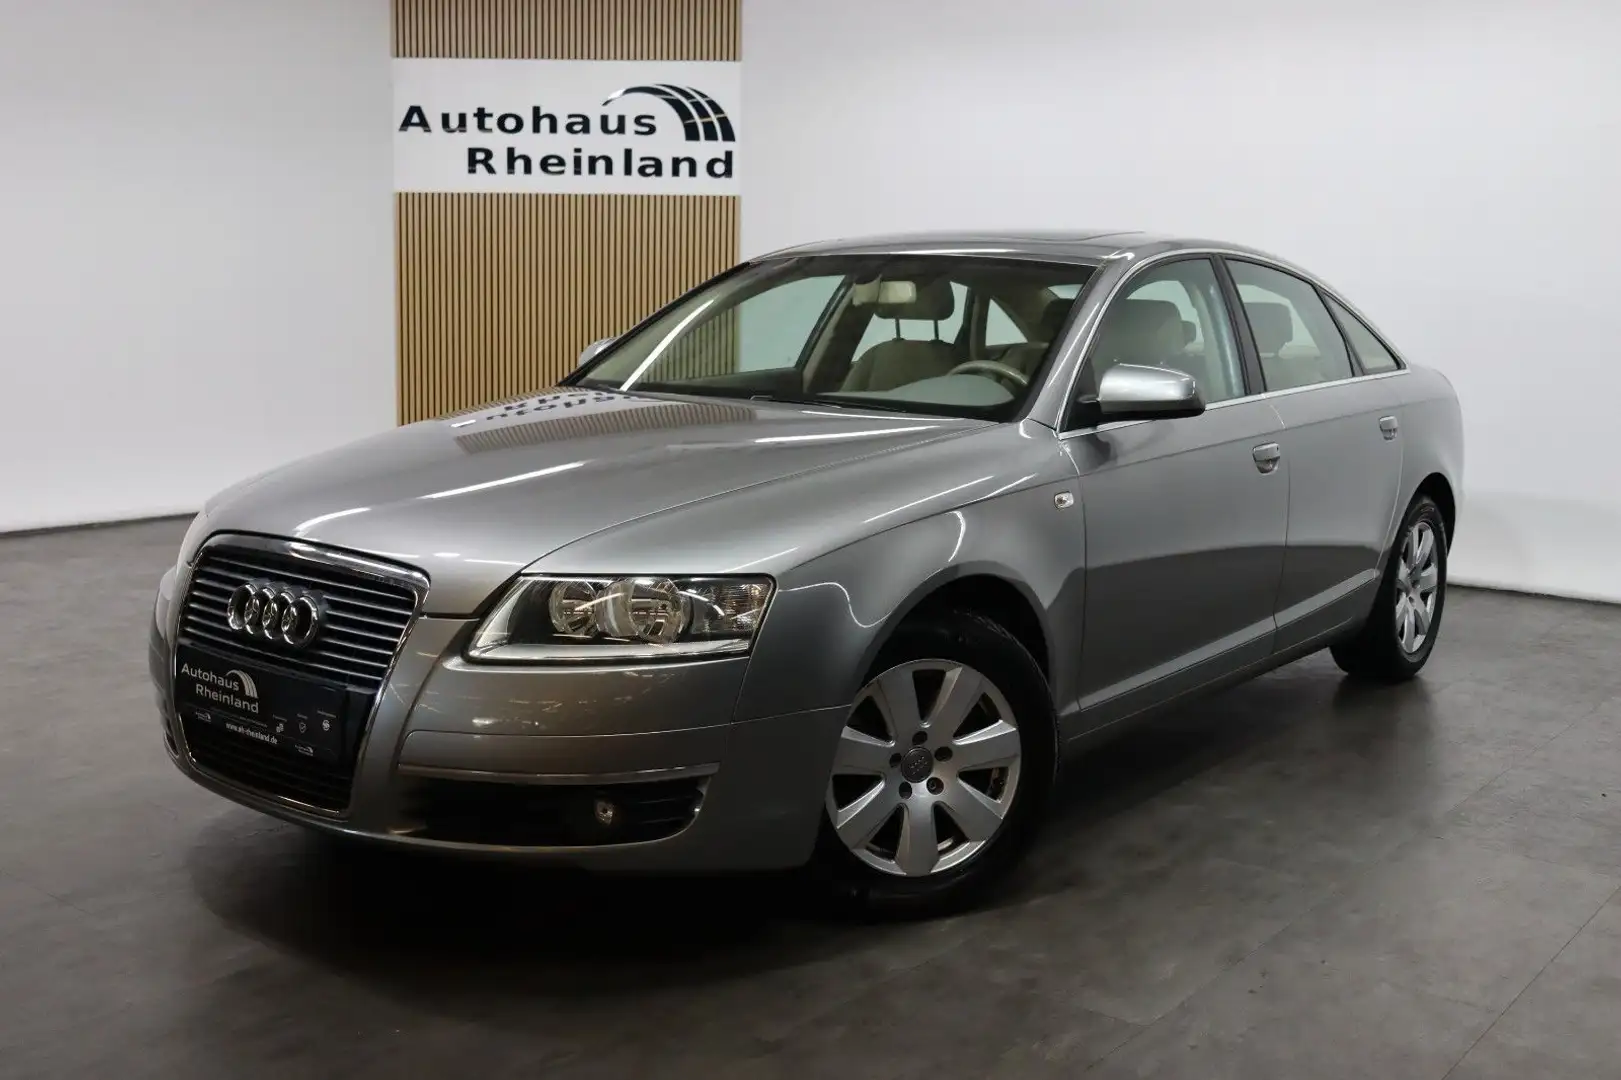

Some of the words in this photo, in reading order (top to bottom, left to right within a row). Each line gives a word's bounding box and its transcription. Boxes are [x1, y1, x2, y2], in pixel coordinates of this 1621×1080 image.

[398, 105, 657, 135] Autohaus
[467, 147, 733, 179] Rheinland
[181, 663, 240, 691] Autohaus
[195, 684, 259, 713] Rheinland
